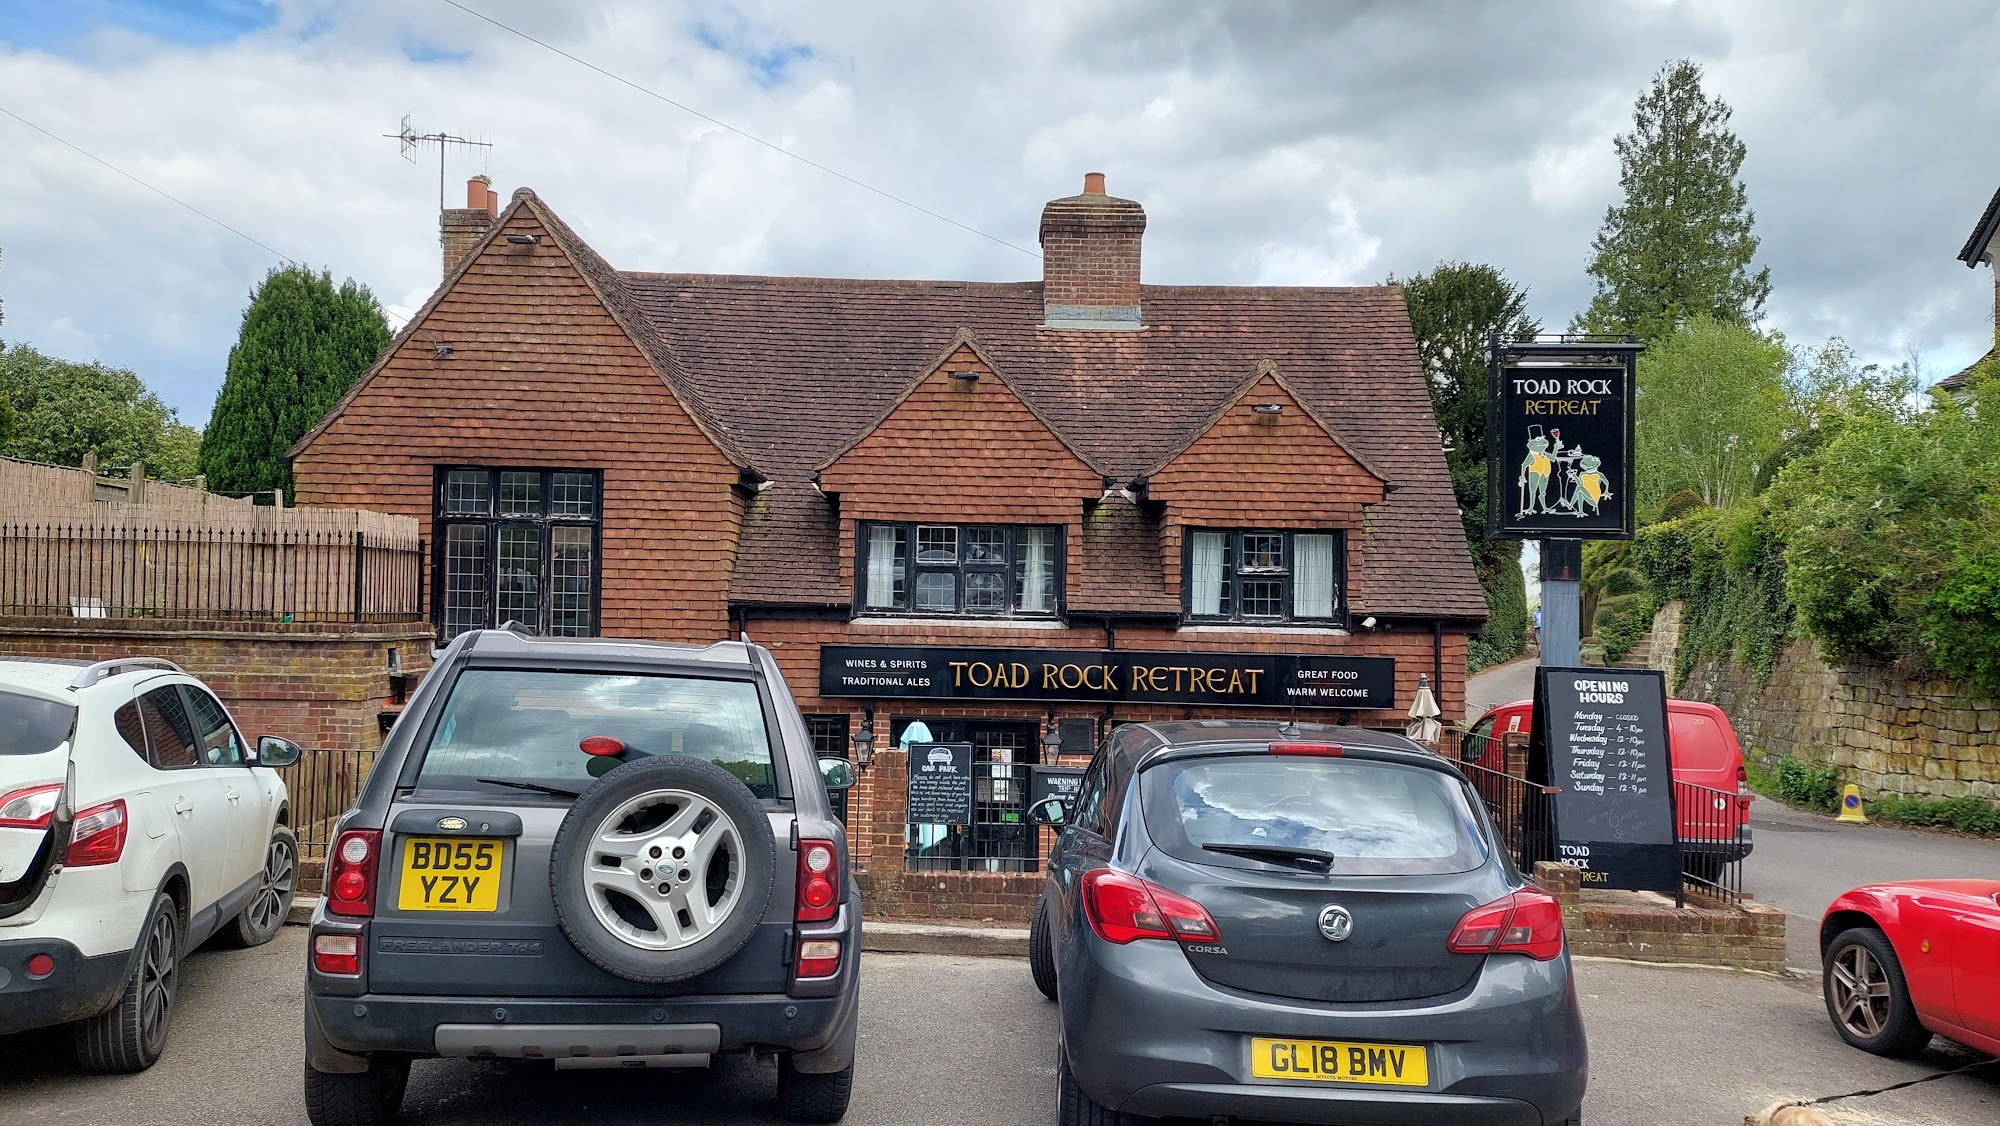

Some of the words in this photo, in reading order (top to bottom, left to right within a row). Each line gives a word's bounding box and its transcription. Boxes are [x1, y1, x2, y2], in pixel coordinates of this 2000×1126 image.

[1513, 379, 1561, 395] TOAD
[1567, 379, 1612, 395] ROCK
[1525, 399, 1601, 415] RETREAT
[845, 659, 877, 669] WINES
[879, 660, 887, 669] &
[890, 660, 927, 669] SPIRITS
[842, 676, 904, 687] TRADITIONAL
[906, 678, 931, 687] ALES
[949, 661, 1029, 689] TOAD
[1042, 663, 1119, 692] ROCK
[1132, 665, 1264, 695] RETREAT
[1297, 670, 1328, 680] GREAT
[1331, 670, 1358, 680] FOOD
[1287, 687, 1317, 697] WARM
[1320, 688, 1369, 698] WELCOME
[1573, 680, 1629, 693] OPENING
[1580, 692, 1624, 704] HOURS
[1573, 710, 1603, 723] Monday
[1615, 713, 1639, 721] CLOSED
[1574, 721, 1605, 734] Tuesday
[1569, 733, 1608, 746] Wednesday
[1570, 745, 1605, 759] Thursday
[921, 764, 936, 772] CAR
[939, 764, 958, 773] PARK
[1572, 758, 1600, 770] Friday
[1570, 770, 1605, 783] Saturday
[1573, 781, 1605, 796] Sunday
[411, 842, 494, 871] BD55
[1560, 845, 1590, 857] TOAD
[420, 875, 481, 904] YZY
[383, 939, 502, 952] FREELANDER
[1187, 944, 1229, 955] CORSA
[1271, 1043, 1338, 1074] GL18
[1349, 1047, 1405, 1078] BMV
